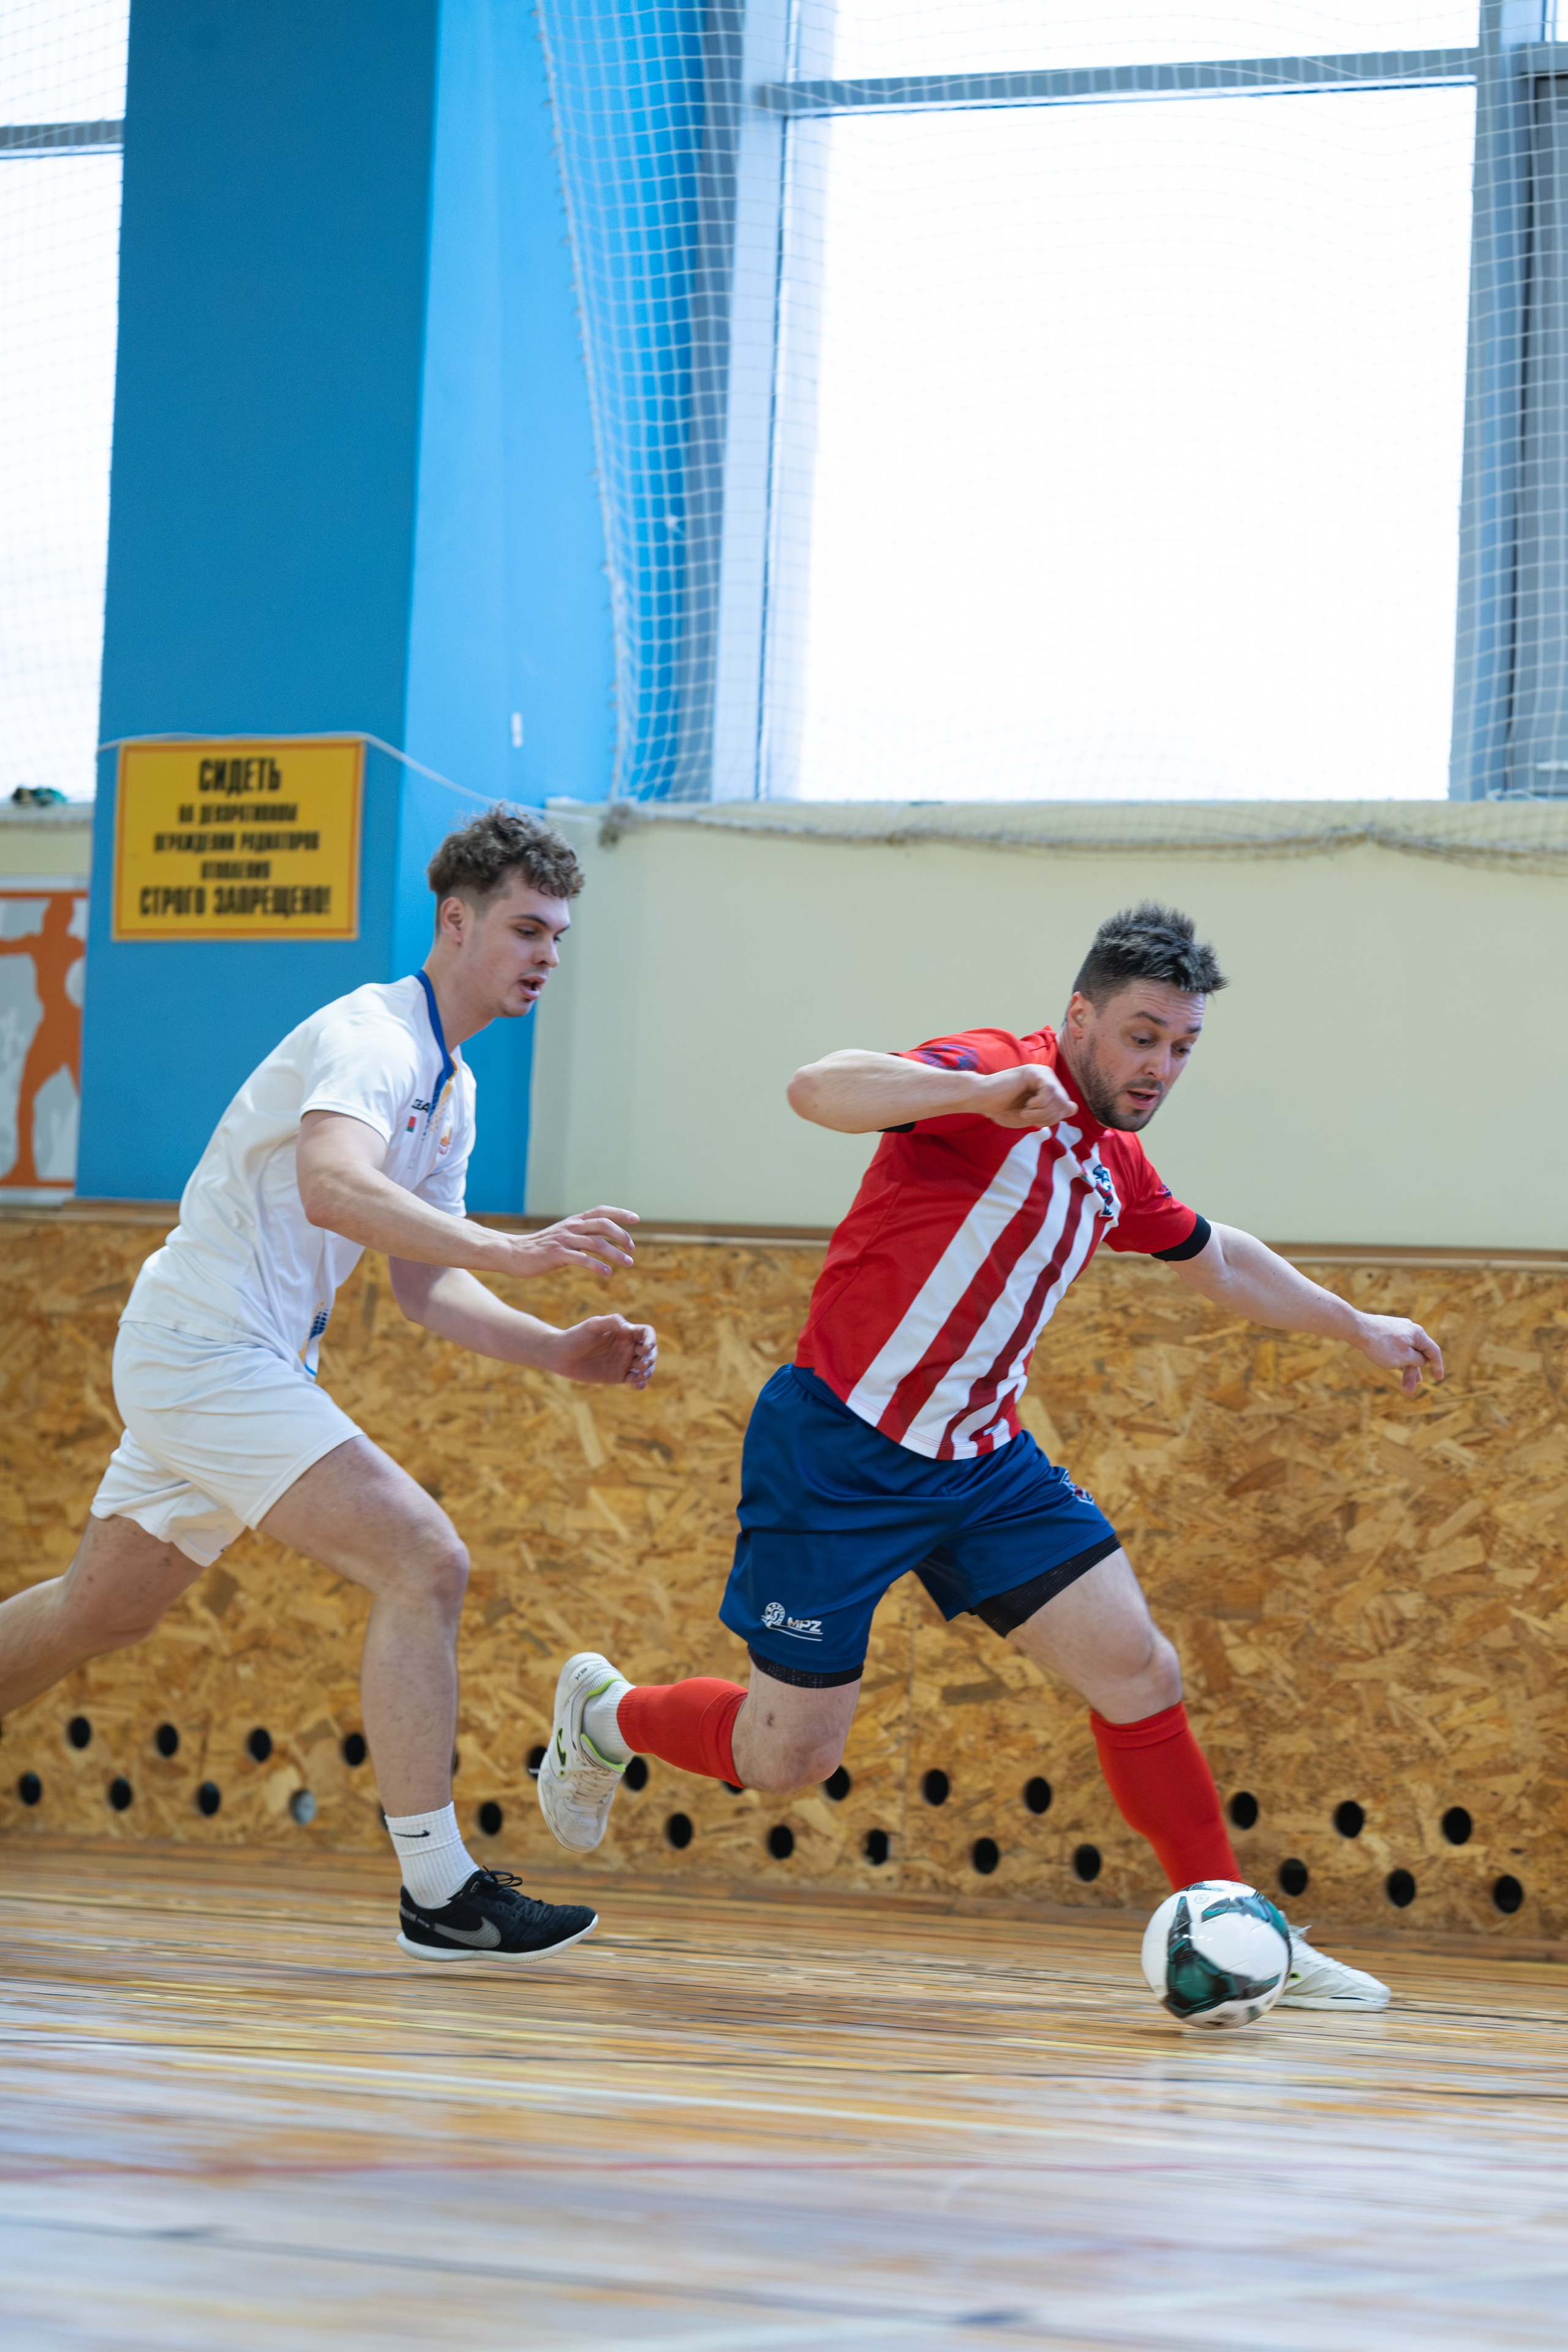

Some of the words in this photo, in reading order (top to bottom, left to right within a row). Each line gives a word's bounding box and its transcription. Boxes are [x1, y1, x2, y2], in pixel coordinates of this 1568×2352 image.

[200, 758, 281, 796] СИДЕТЬ
[140, 886, 205, 916] СТРОГО
[214, 885, 331, 918] ЗАПРЕЩЕНО!
